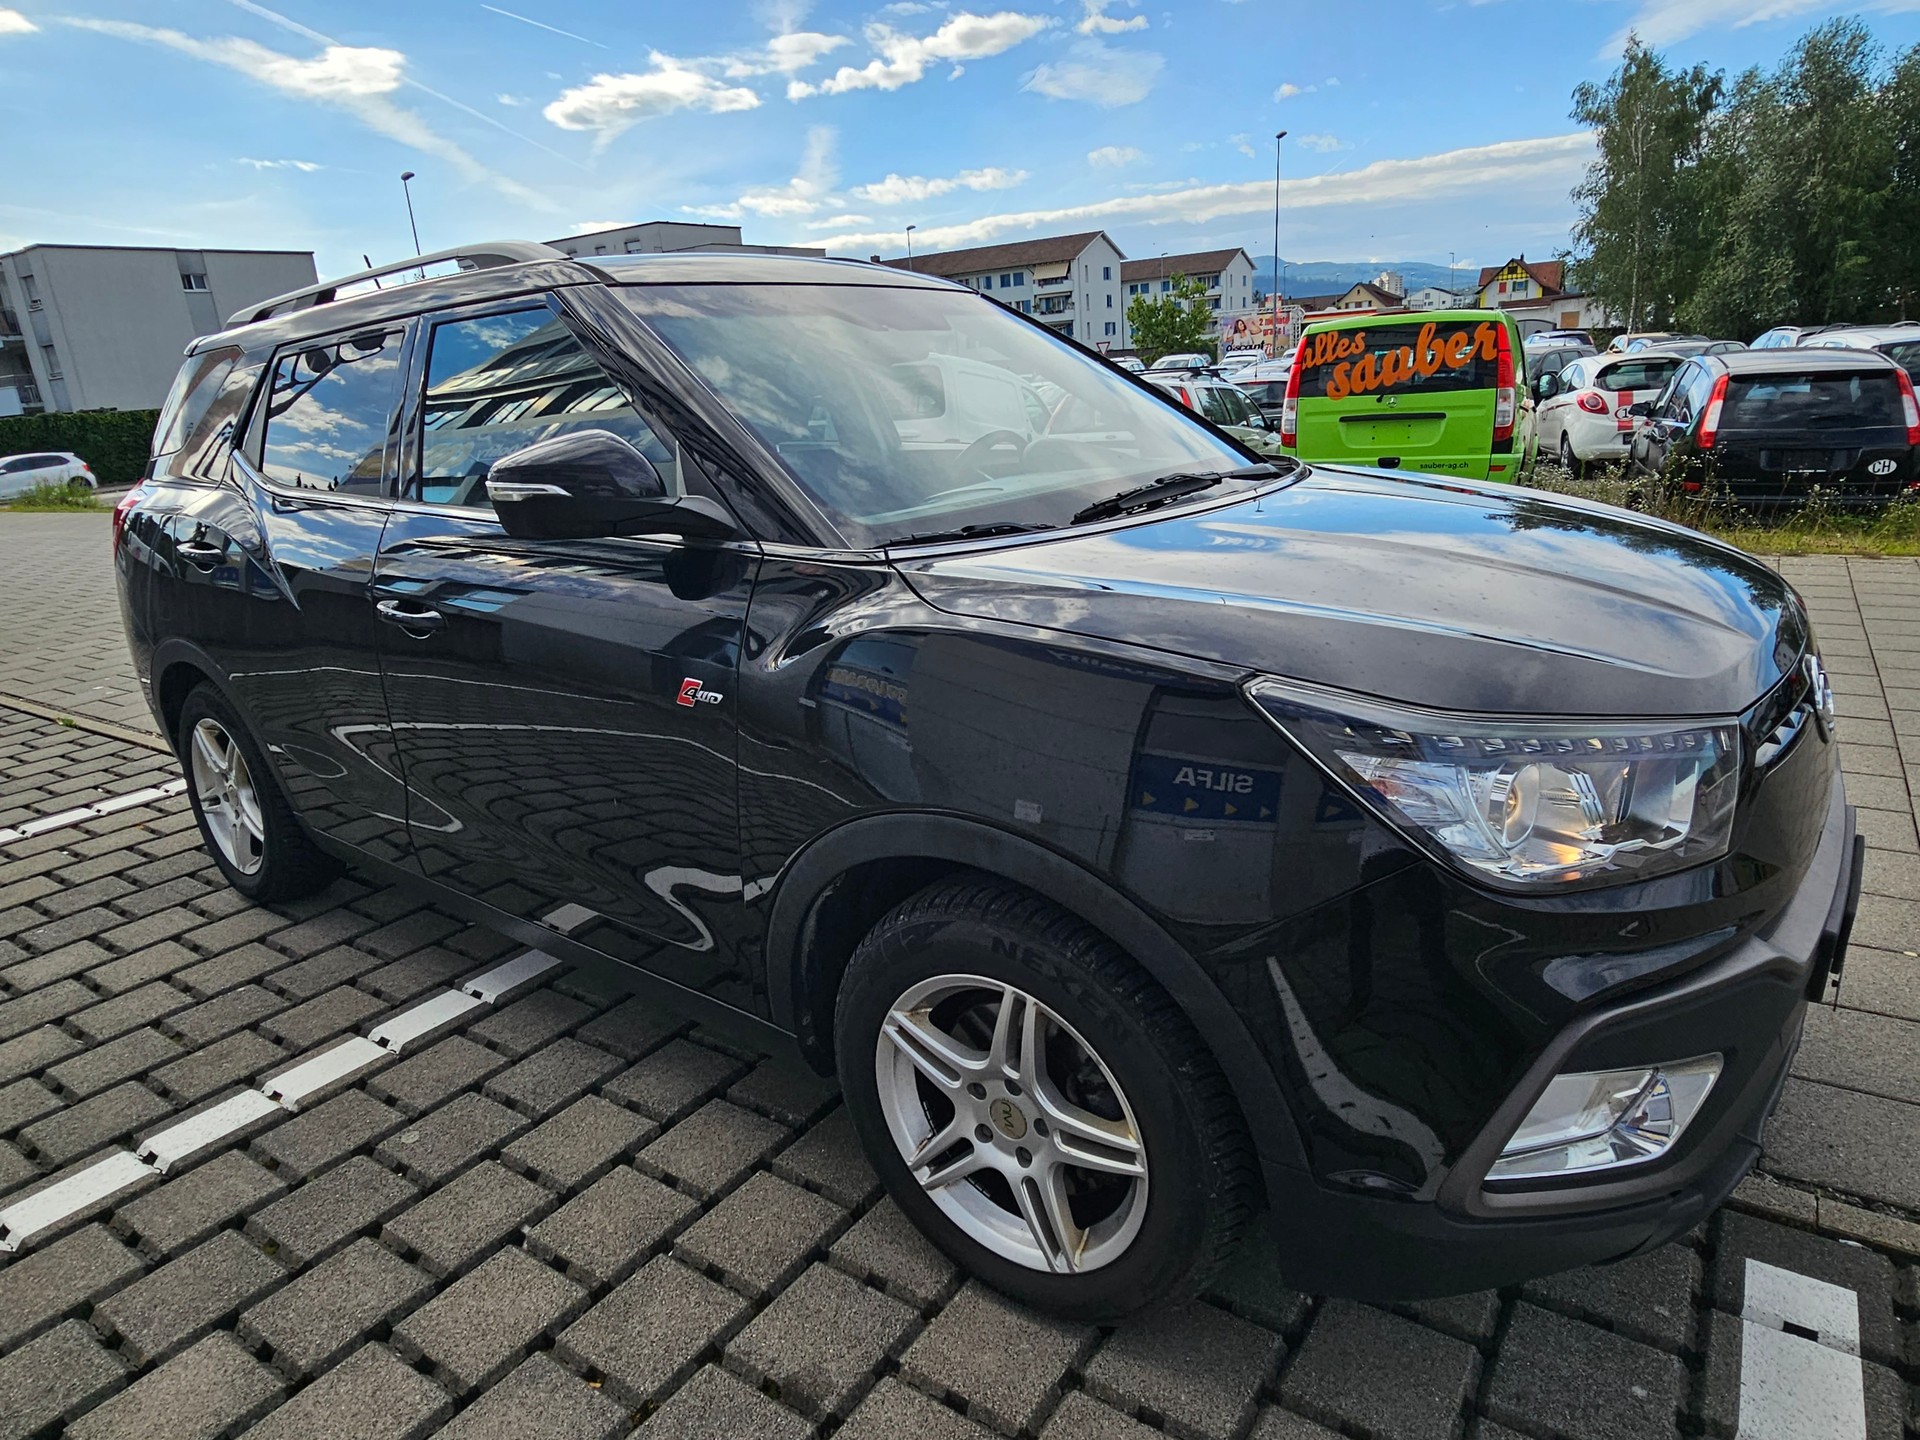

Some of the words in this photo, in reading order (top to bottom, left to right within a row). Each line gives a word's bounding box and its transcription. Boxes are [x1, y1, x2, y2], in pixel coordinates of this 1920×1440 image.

[1302, 330, 1366, 371] alles
[1326, 321, 1498, 401] sauber
[1420, 461, 1469, 470] sauber-ag.ch
[1872, 460, 1892, 474] CH
[680, 683, 724, 706] 4WD
[991, 936, 1130, 1043] NEXEN
